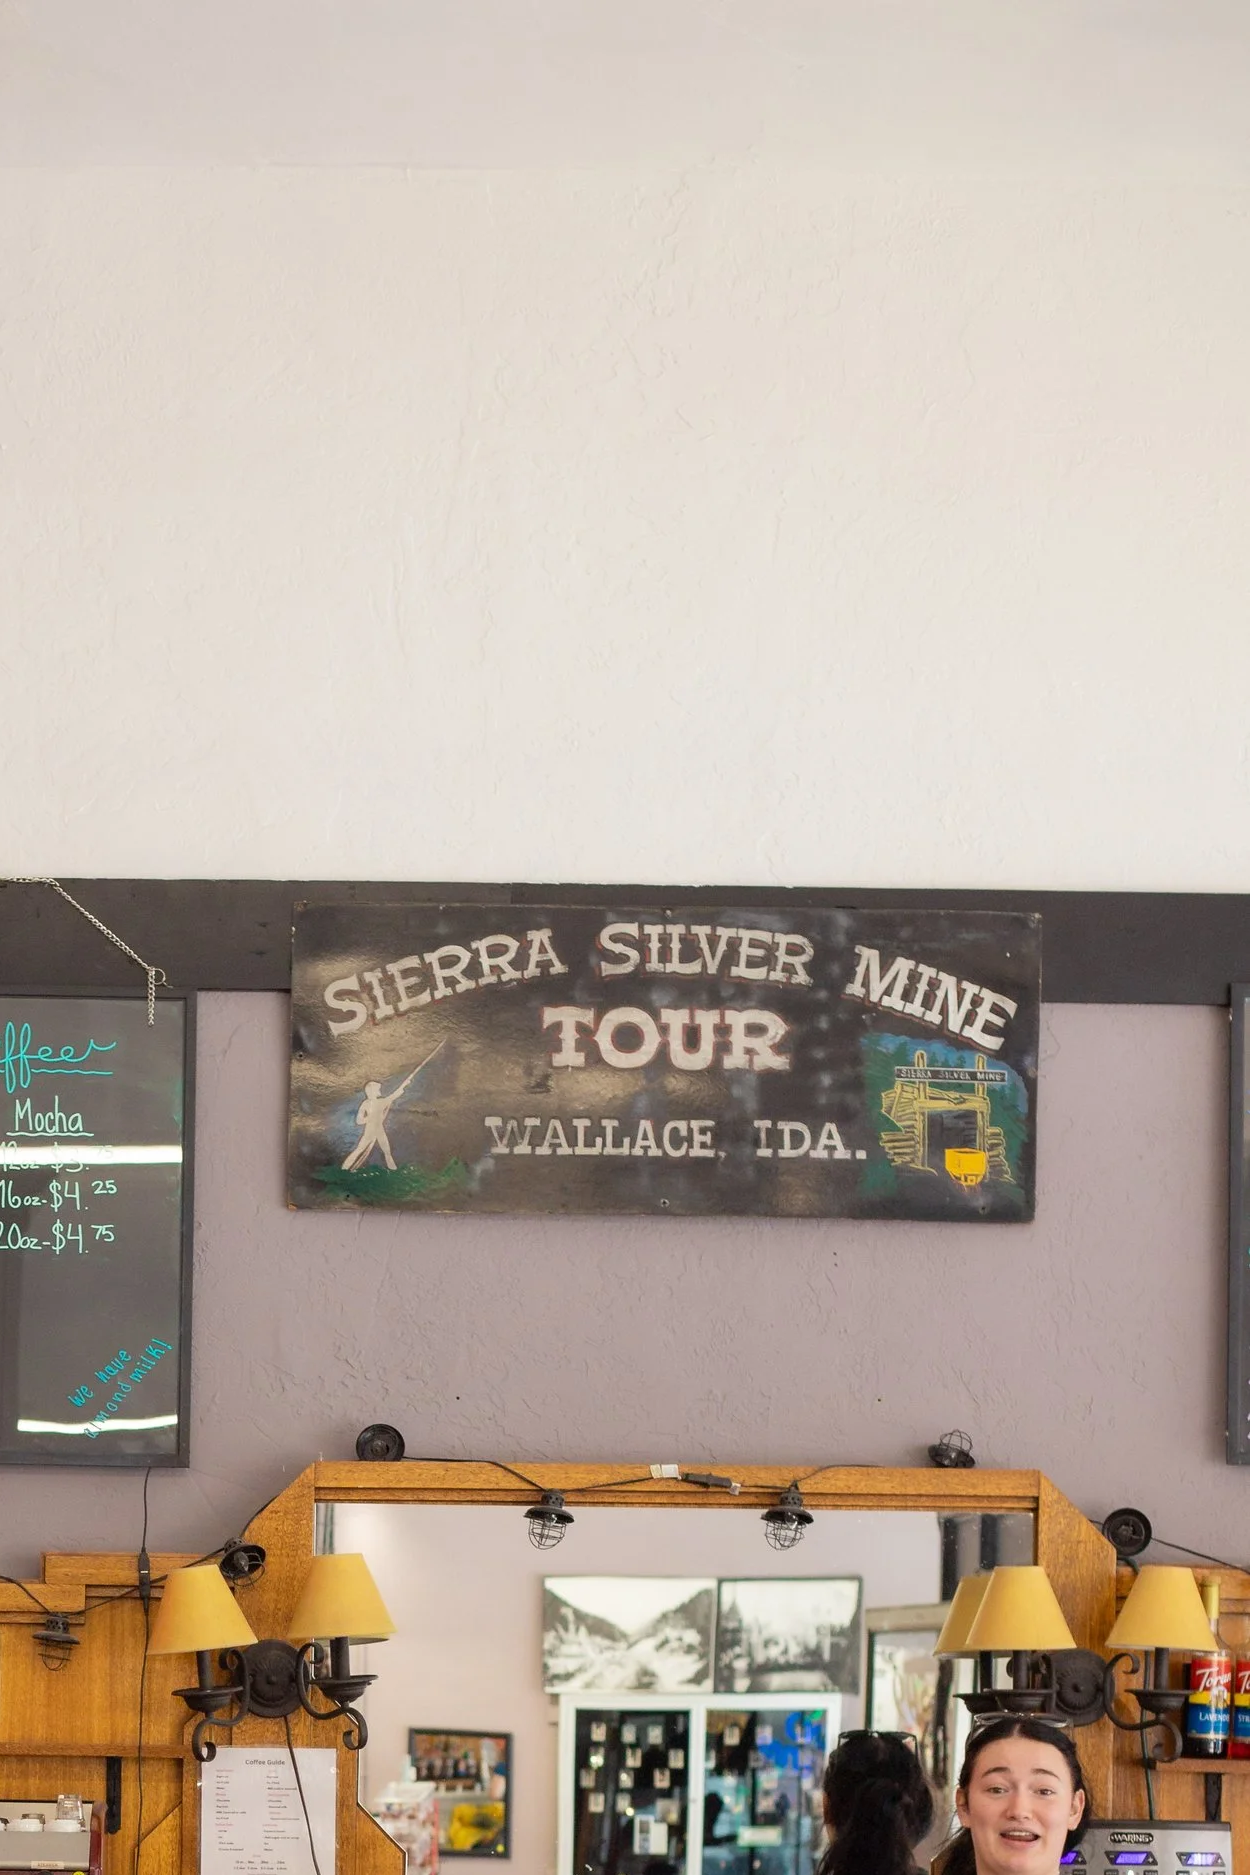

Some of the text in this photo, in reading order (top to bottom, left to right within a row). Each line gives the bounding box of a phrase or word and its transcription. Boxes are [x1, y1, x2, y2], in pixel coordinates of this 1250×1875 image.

[323, 922, 1019, 1051] SIERRA SILVER MINE
[541, 1006, 792, 1072] TOUR
[977, 1071, 1002, 1081] MINE
[14, 1095, 84, 1133] Mocha
[484, 1114, 867, 1161] WALLACE, IDA.
[67, 1349, 132, 1408] We have
[1113, 1833, 1150, 1843] WARING
